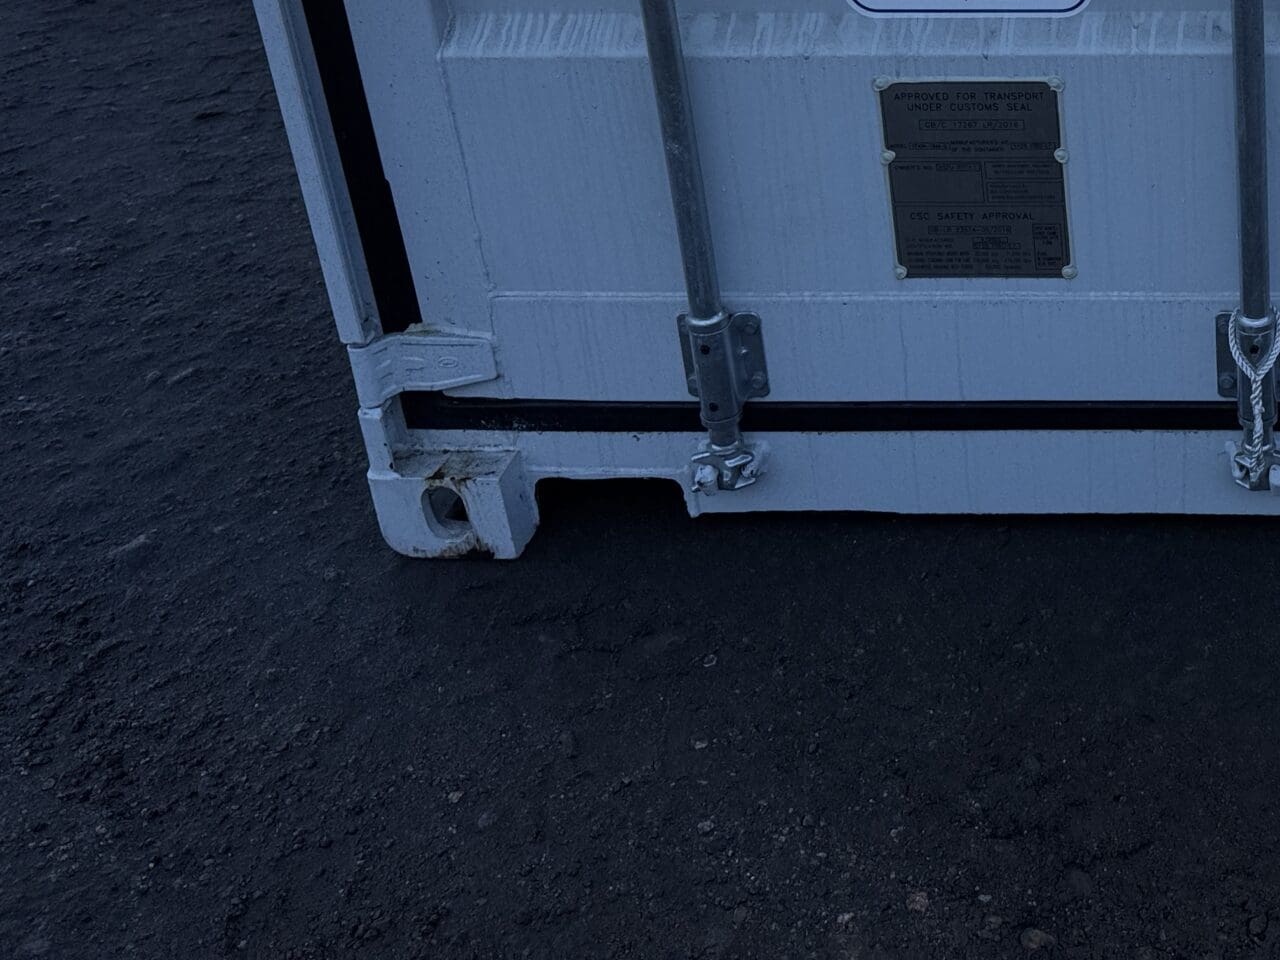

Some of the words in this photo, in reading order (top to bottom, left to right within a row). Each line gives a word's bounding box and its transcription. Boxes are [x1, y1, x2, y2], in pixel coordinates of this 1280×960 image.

[894, 92, 949, 101] APPROVED
[956, 92, 977, 101] FOR
[984, 92, 1044, 101] TRANSPORT
[907, 103, 942, 112] UNDER
[950, 103, 999, 112] CUSTOMS
[1006, 102, 1033, 111] SEAL
[937, 212, 975, 221] SAFETY
[982, 212, 1035, 221] APPROVAL
